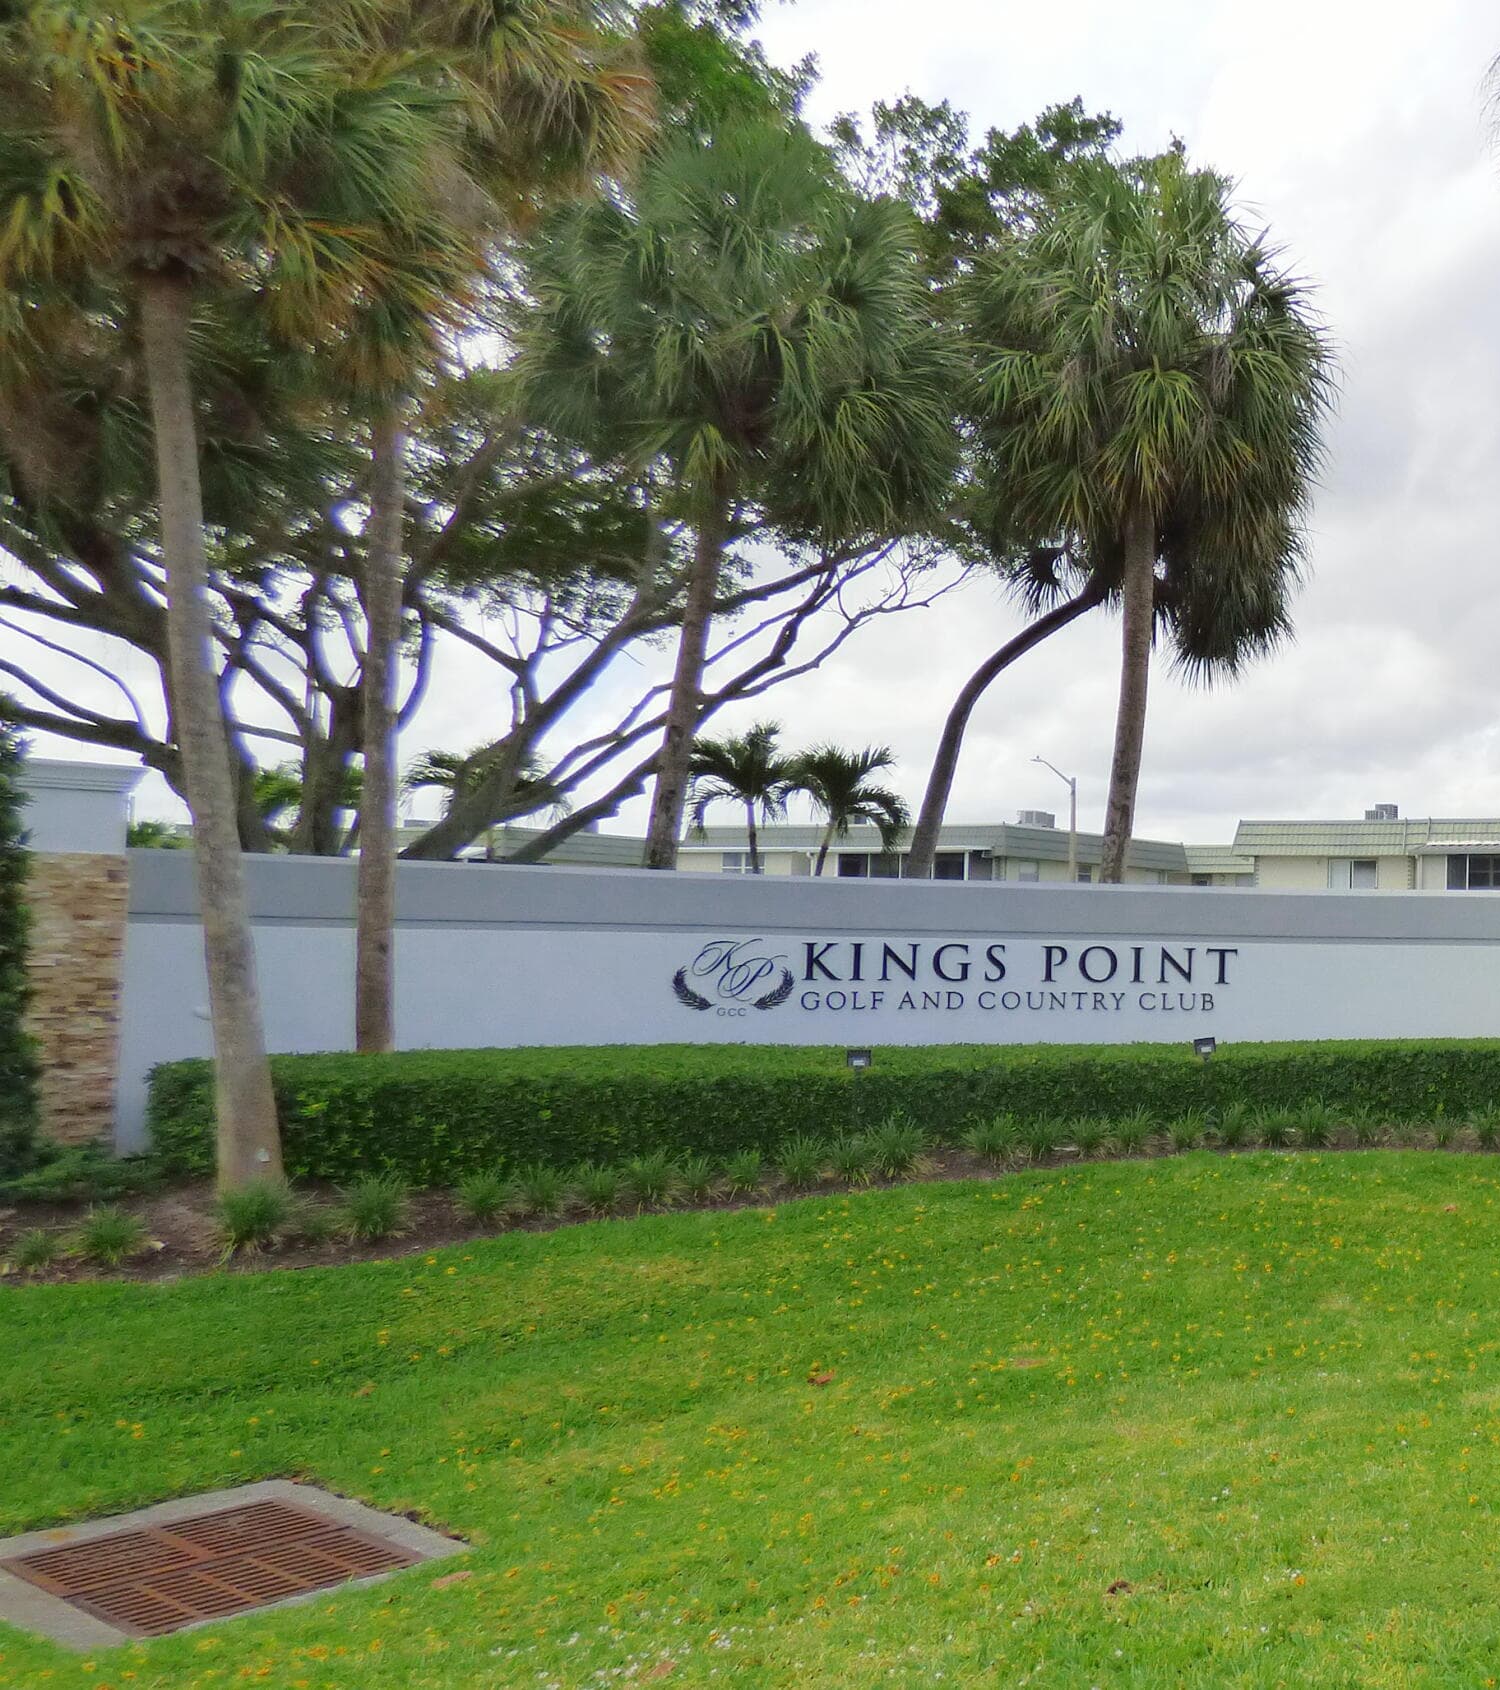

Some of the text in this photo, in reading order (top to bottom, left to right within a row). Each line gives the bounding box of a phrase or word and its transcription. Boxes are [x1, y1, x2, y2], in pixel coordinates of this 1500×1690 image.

[801, 941, 1238, 985] KINGS POINT
[801, 990, 1215, 1011] GOLF AND COUNTRY CLUB
[716, 1007, 746, 1017] GCC
